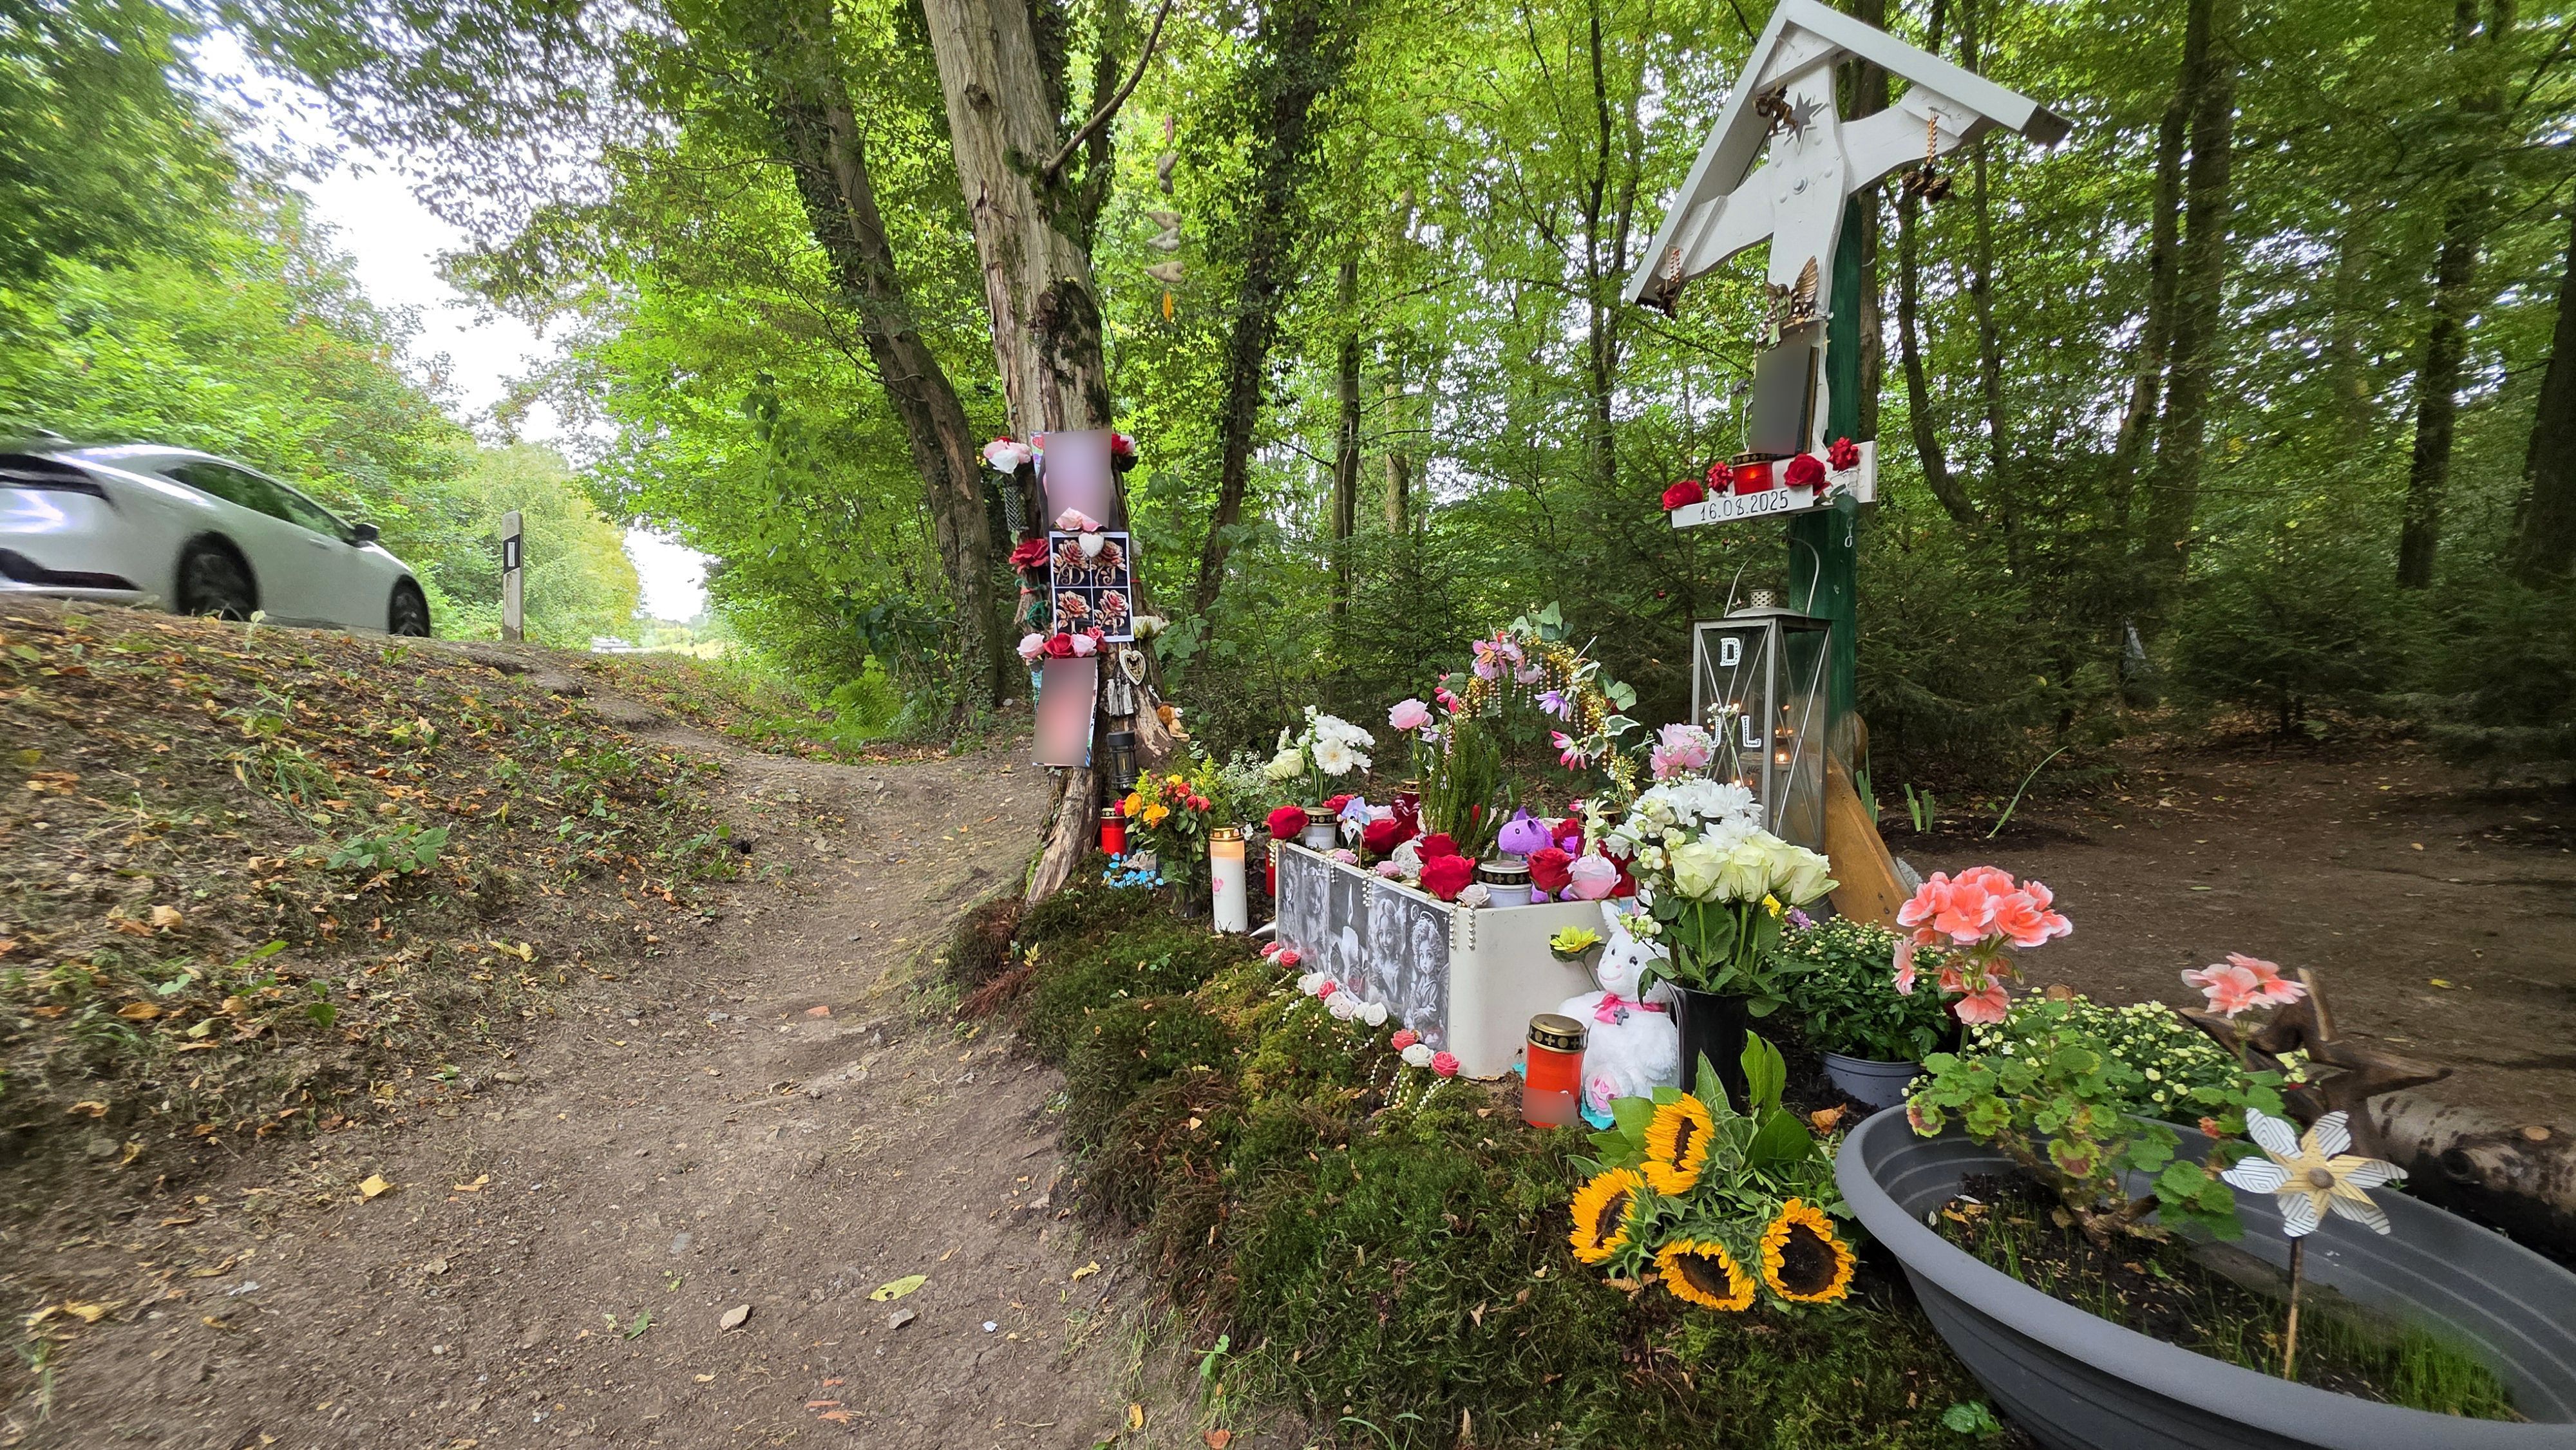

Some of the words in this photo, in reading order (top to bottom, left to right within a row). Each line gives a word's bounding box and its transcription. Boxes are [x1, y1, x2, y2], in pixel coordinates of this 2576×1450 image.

[1700, 489, 1788, 521] 16.08.2025
[1061, 566, 1085, 585] D
[1111, 616, 1125, 636] P
[1719, 637, 1740, 666] D
[1711, 715, 1721, 748] J
[1740, 715, 1761, 748] L
